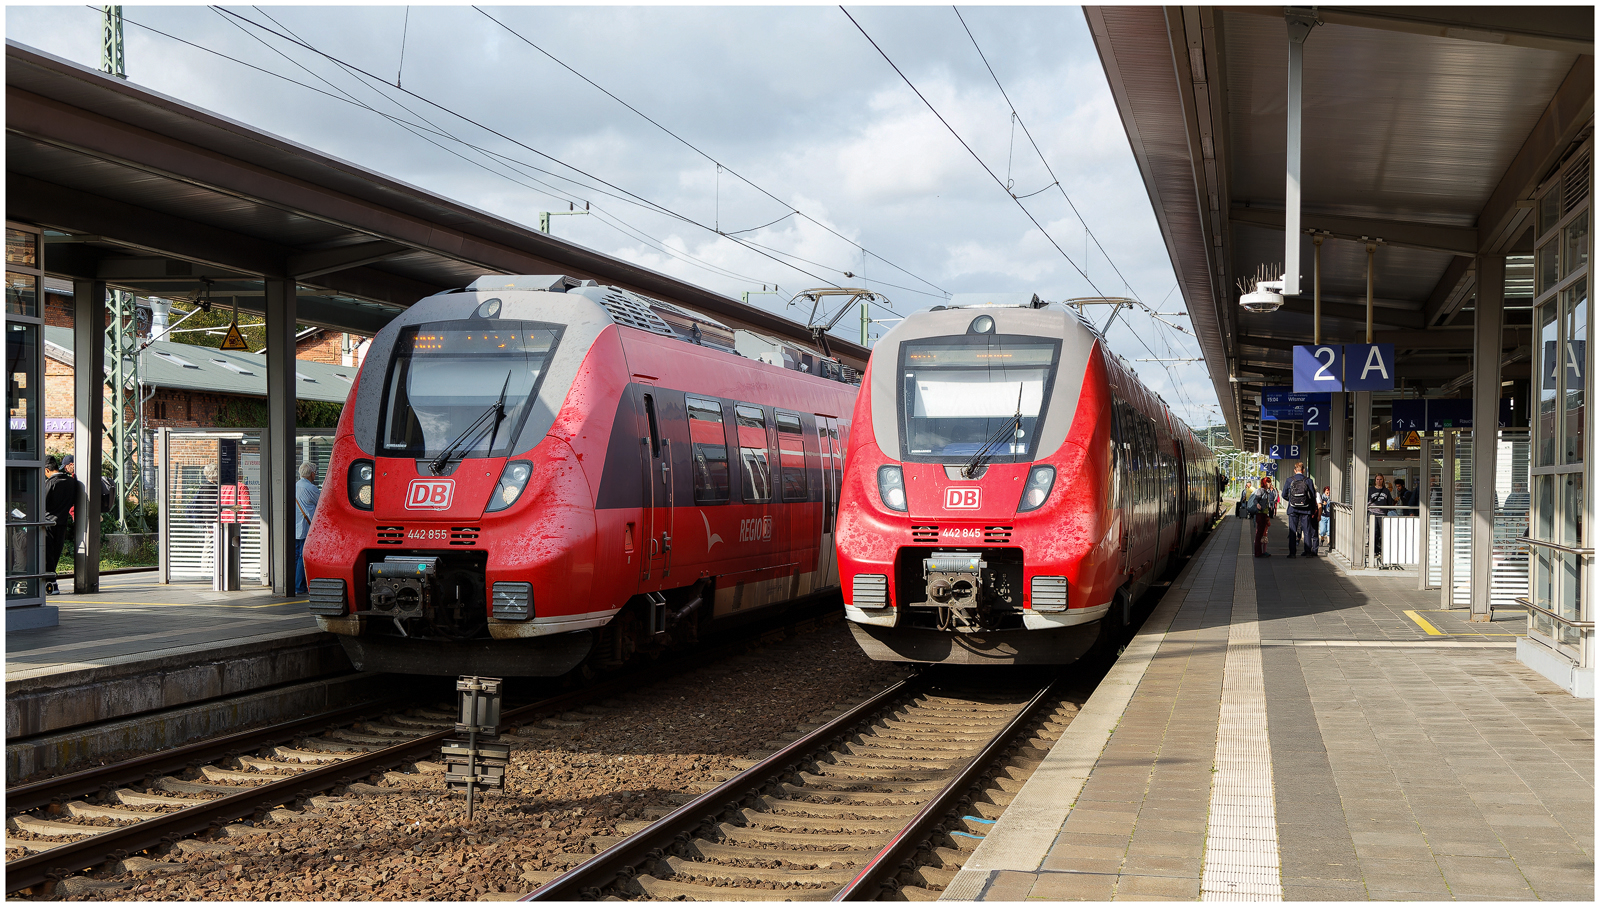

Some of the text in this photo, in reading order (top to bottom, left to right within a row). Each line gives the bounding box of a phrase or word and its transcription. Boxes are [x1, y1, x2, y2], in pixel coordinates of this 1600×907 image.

[1313, 345, 1389, 381] 2 A
[1307, 406, 1319, 426] 2
[1271, 444, 1299, 457] 2 B
[1271, 462, 1278, 471] C
[411, 483, 448, 505] DB
[948, 490, 977, 506] DB
[407, 529, 448, 540] 442 855
[739, 517, 763, 542] REGIO
[942, 528, 981, 538] 442 845
